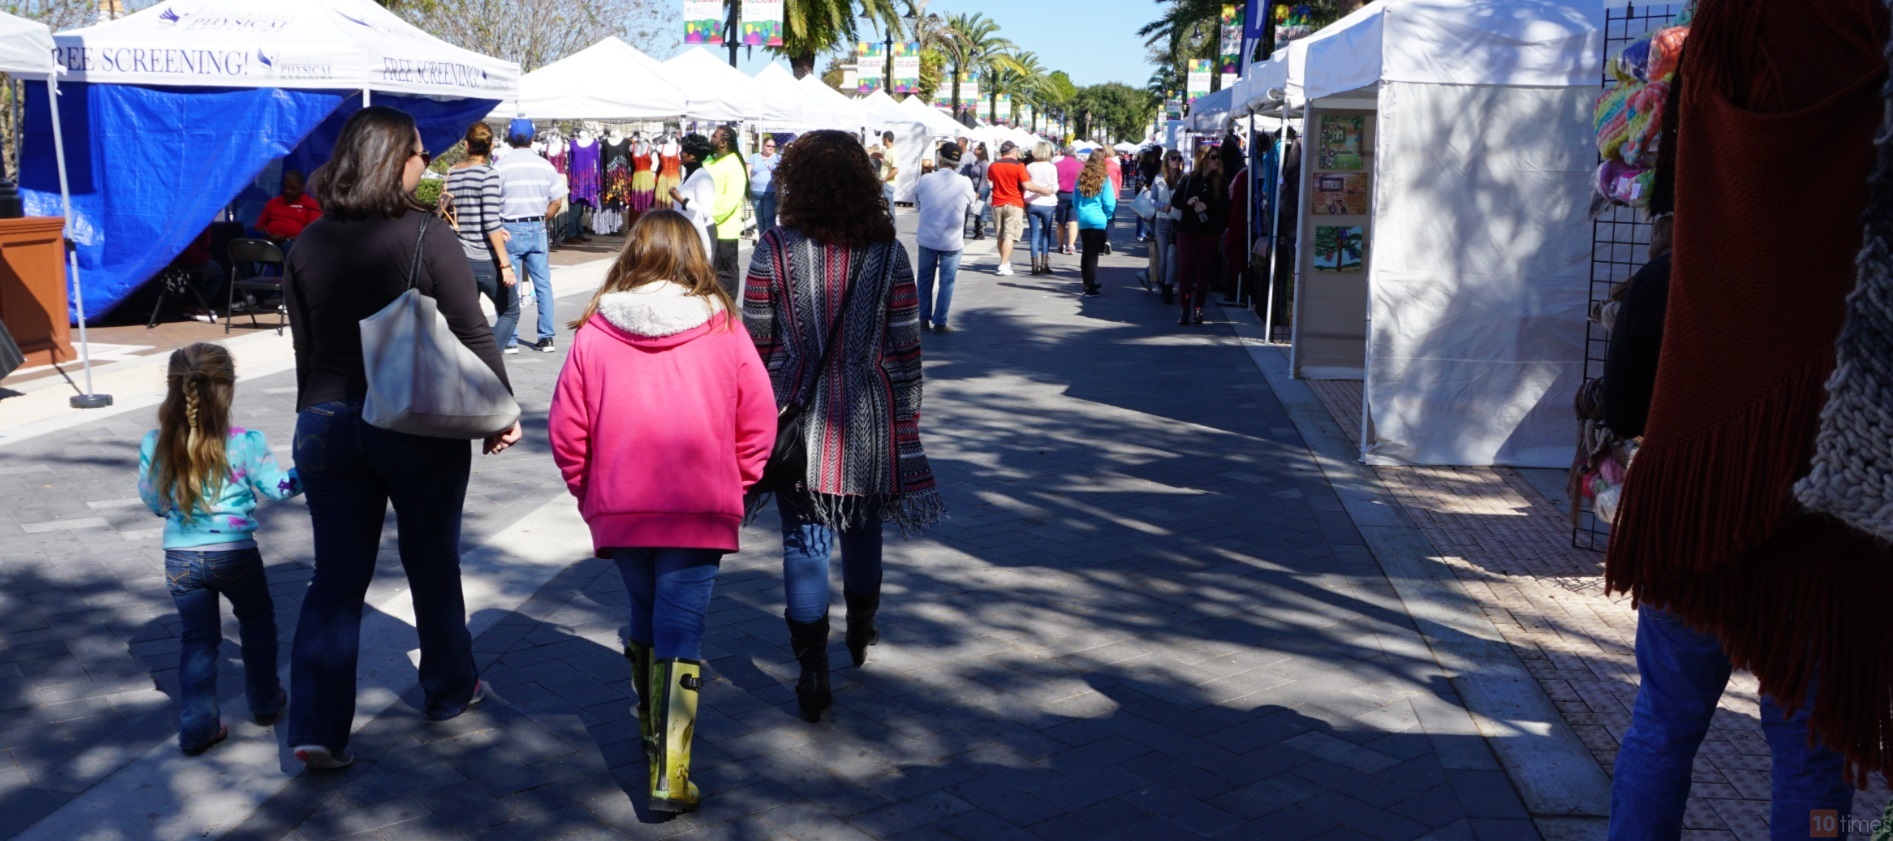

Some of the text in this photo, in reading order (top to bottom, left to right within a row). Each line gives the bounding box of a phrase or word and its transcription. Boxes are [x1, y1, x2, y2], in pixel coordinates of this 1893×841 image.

[52, 46, 249, 76] REE SCREENING!
[281, 65, 332, 74] PHYSICAL
[383, 57, 480, 88] FREE SCREENING!
